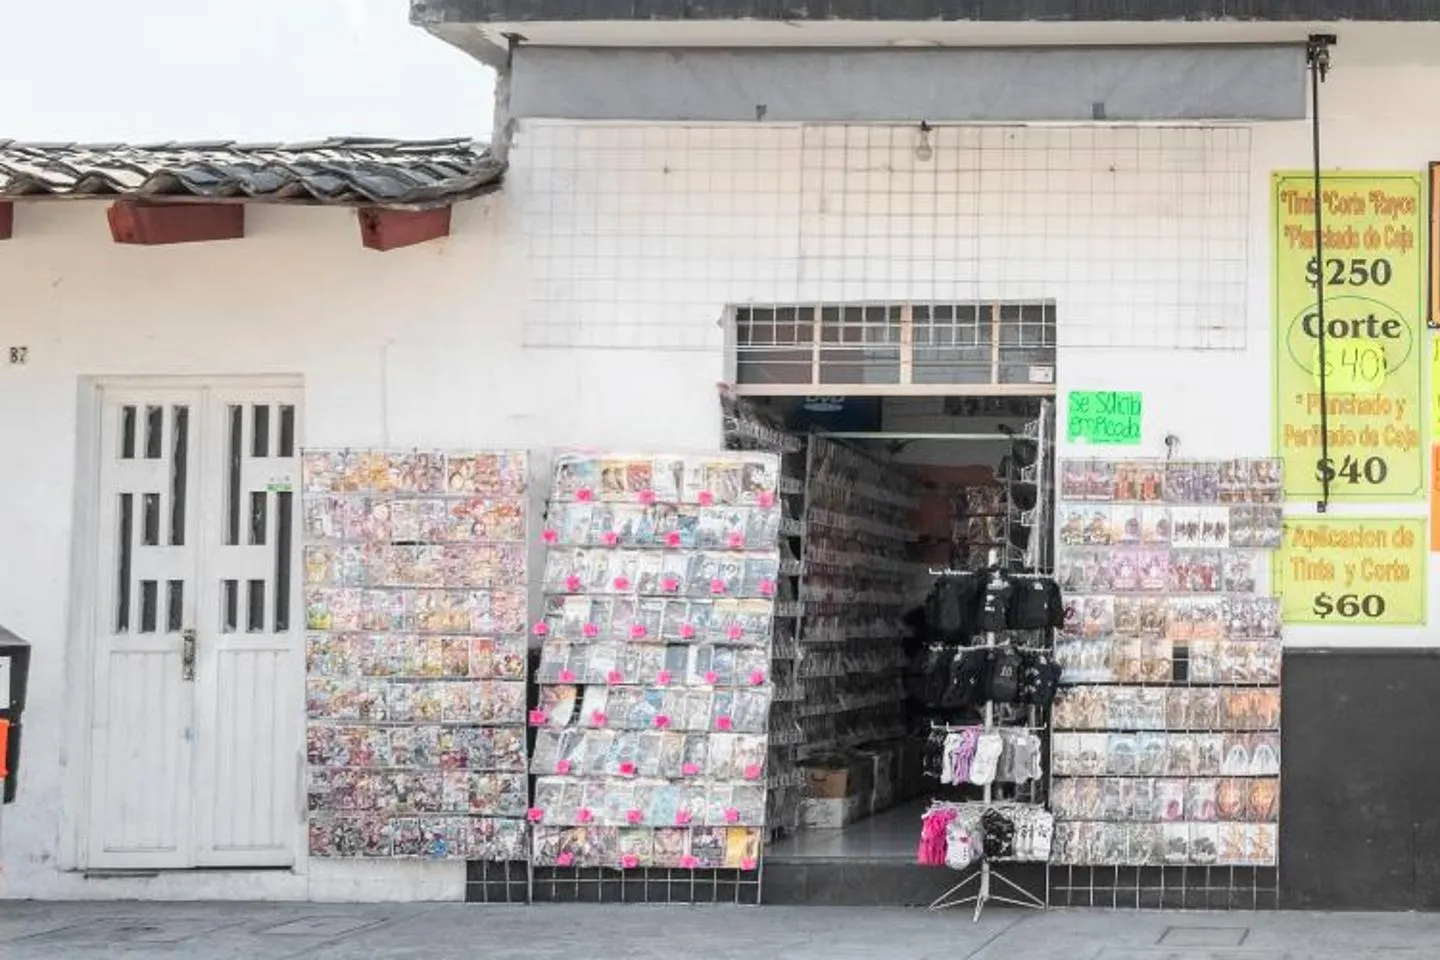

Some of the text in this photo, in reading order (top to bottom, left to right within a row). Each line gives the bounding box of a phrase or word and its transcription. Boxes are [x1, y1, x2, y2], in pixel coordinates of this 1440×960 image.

[1305, 257, 1392, 287] $250
[1302, 313, 1401, 338] Corte
[1315, 455, 1388, 484] $40
[1344, 563, 1357, 588] y
[1313, 592, 1386, 619] $60
